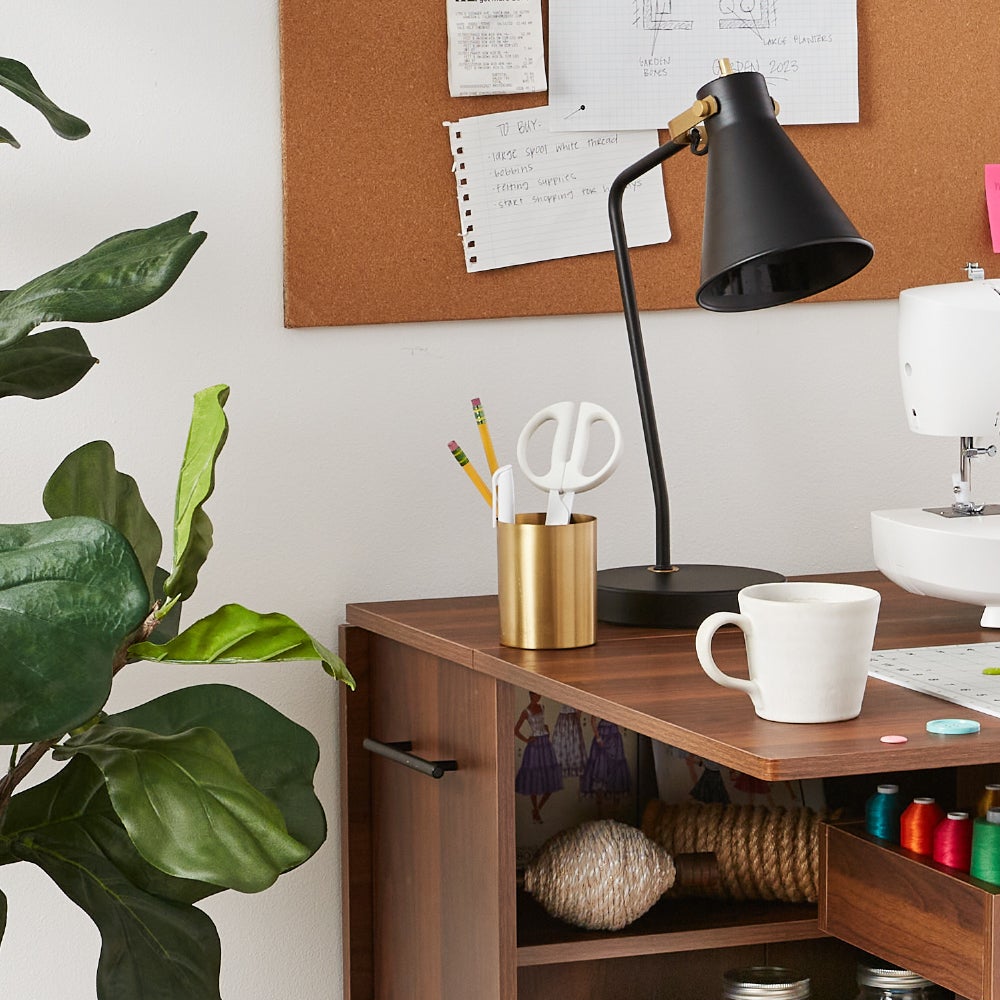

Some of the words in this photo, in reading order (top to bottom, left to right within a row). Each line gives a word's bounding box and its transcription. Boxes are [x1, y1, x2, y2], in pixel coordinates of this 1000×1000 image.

[793, 34, 833, 45] PLANTERS
[639, 56, 671, 67] GARDEN
[768, 59, 799, 74] 2023
[496, 122, 509, 137] TO
[525, 144, 548, 159] spool
[556, 140, 580, 153] white
[494, 163, 533, 178] bobbins
[537, 172, 577, 186] supplies
[531, 190, 574, 204] shopping
